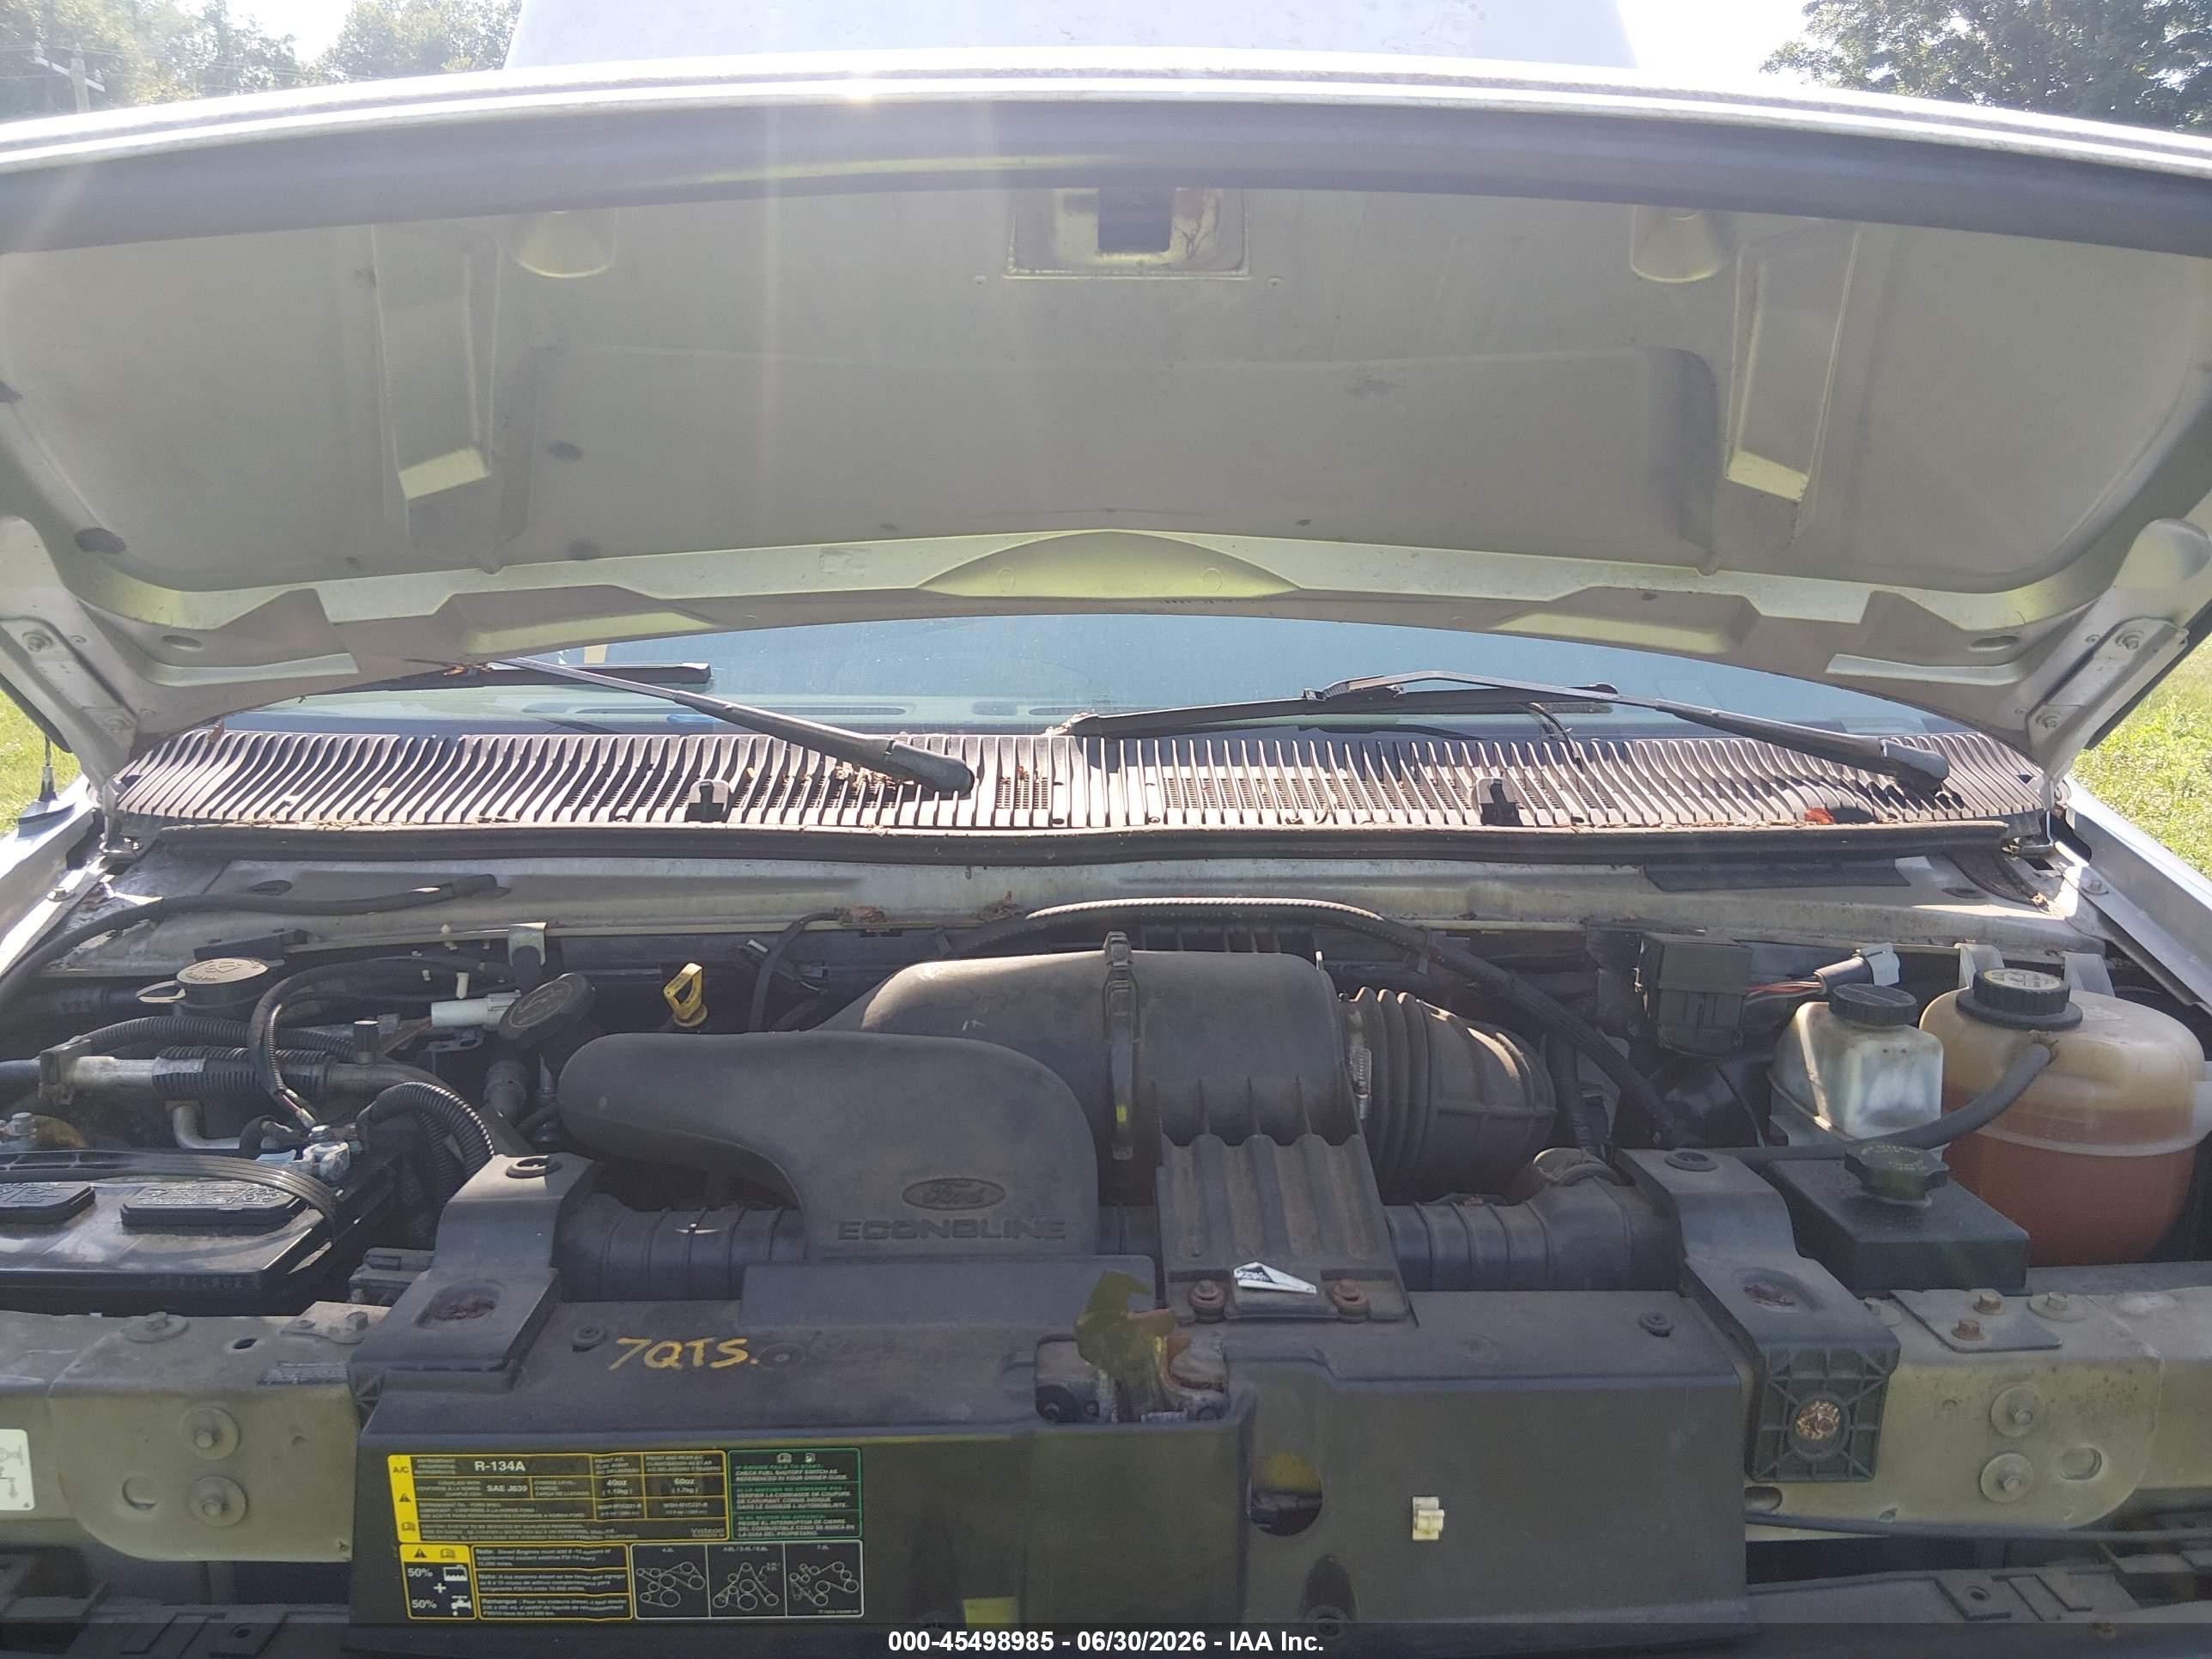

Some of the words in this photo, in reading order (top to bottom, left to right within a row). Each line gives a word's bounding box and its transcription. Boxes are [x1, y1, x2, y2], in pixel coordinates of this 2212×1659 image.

[837, 1218, 1066, 1240] ECONOLINE
[392, 1466, 410, 1474] A/C
[474, 1460, 526, 1473] R-134A
[408, 1568, 433, 1578] 50%
[411, 1599, 437, 1609] 50%
